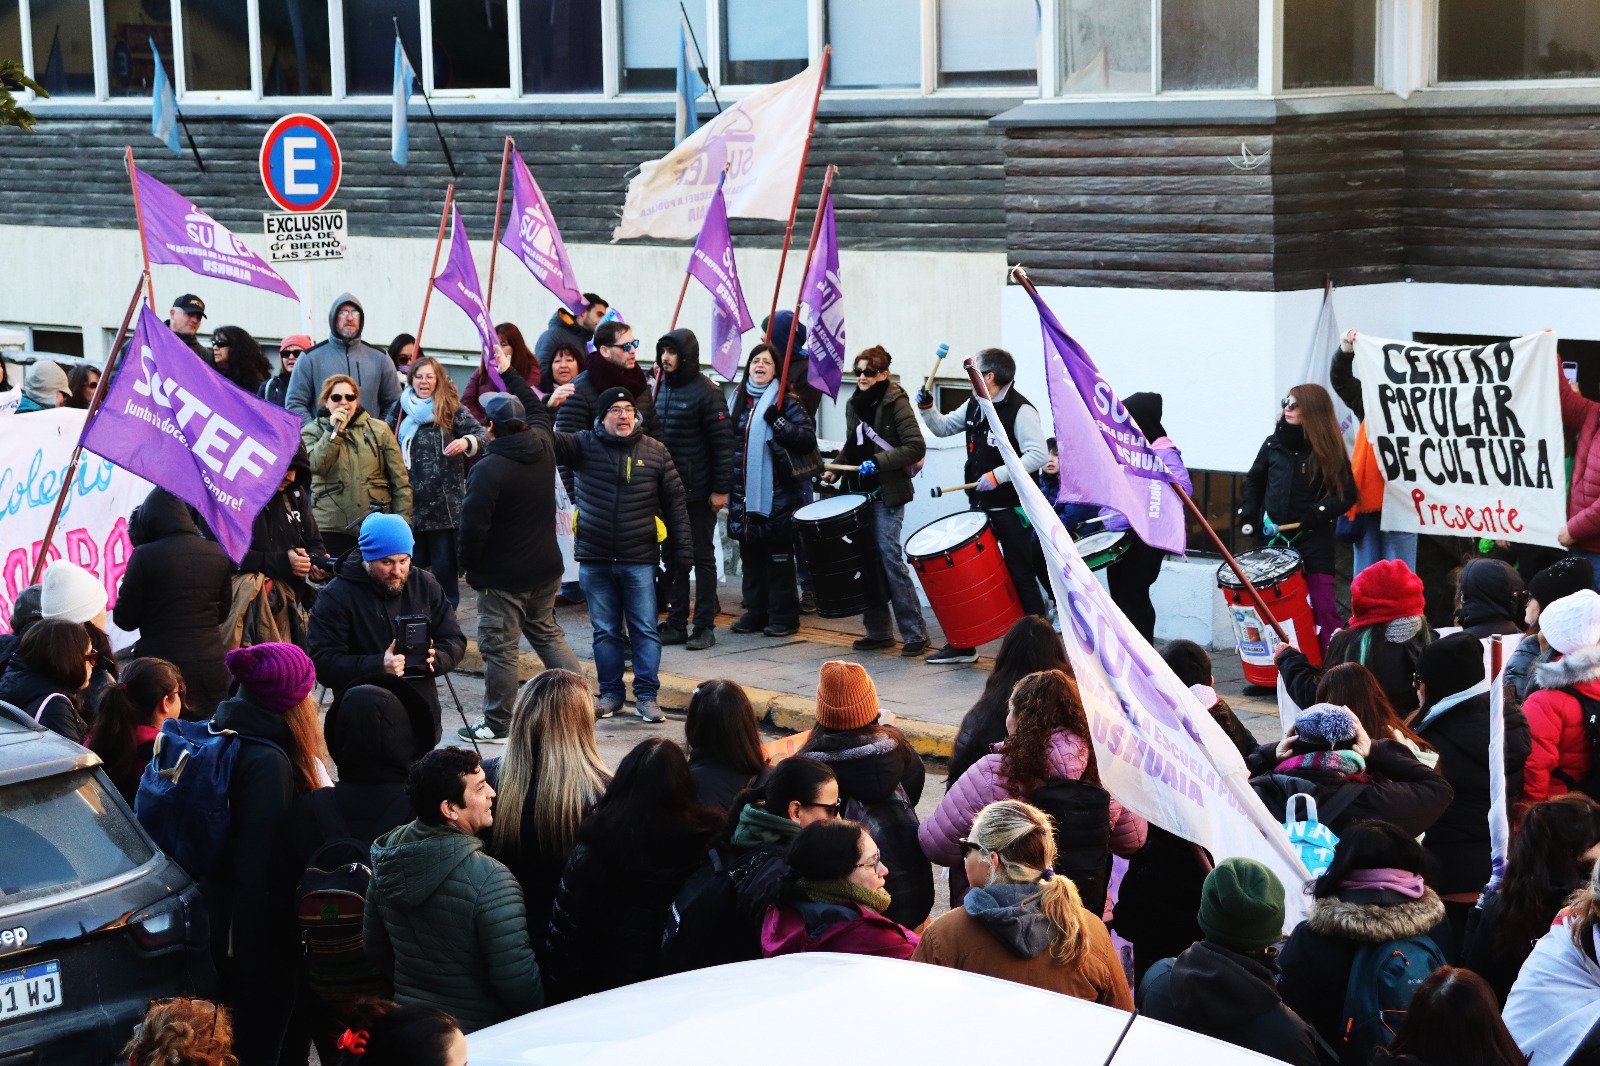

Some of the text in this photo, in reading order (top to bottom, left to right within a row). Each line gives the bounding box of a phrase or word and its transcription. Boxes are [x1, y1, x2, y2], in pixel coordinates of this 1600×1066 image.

[283, 136, 319, 195] E
[266, 214, 343, 234] EXCLUSIVO
[276, 231, 335, 242] CASA DE
[203, 259, 251, 281] USHUAIA
[217, 253, 227, 262] LA
[272, 248, 342, 260] LAS 24 Hs
[1382, 341, 1514, 385] CENTRO
[124, 398, 152, 423] Junto
[132, 344, 278, 482] SUTEF
[1378, 384, 1526, 438] POPULAR
[1377, 436, 1554, 489] DE CULTURA
[1411, 488, 1523, 534] Presente
[1093, 710, 1205, 808] USHUAIA
[1153, 724, 1216, 793] ESCUELA
[26, 976, 56, 1007] WJ
